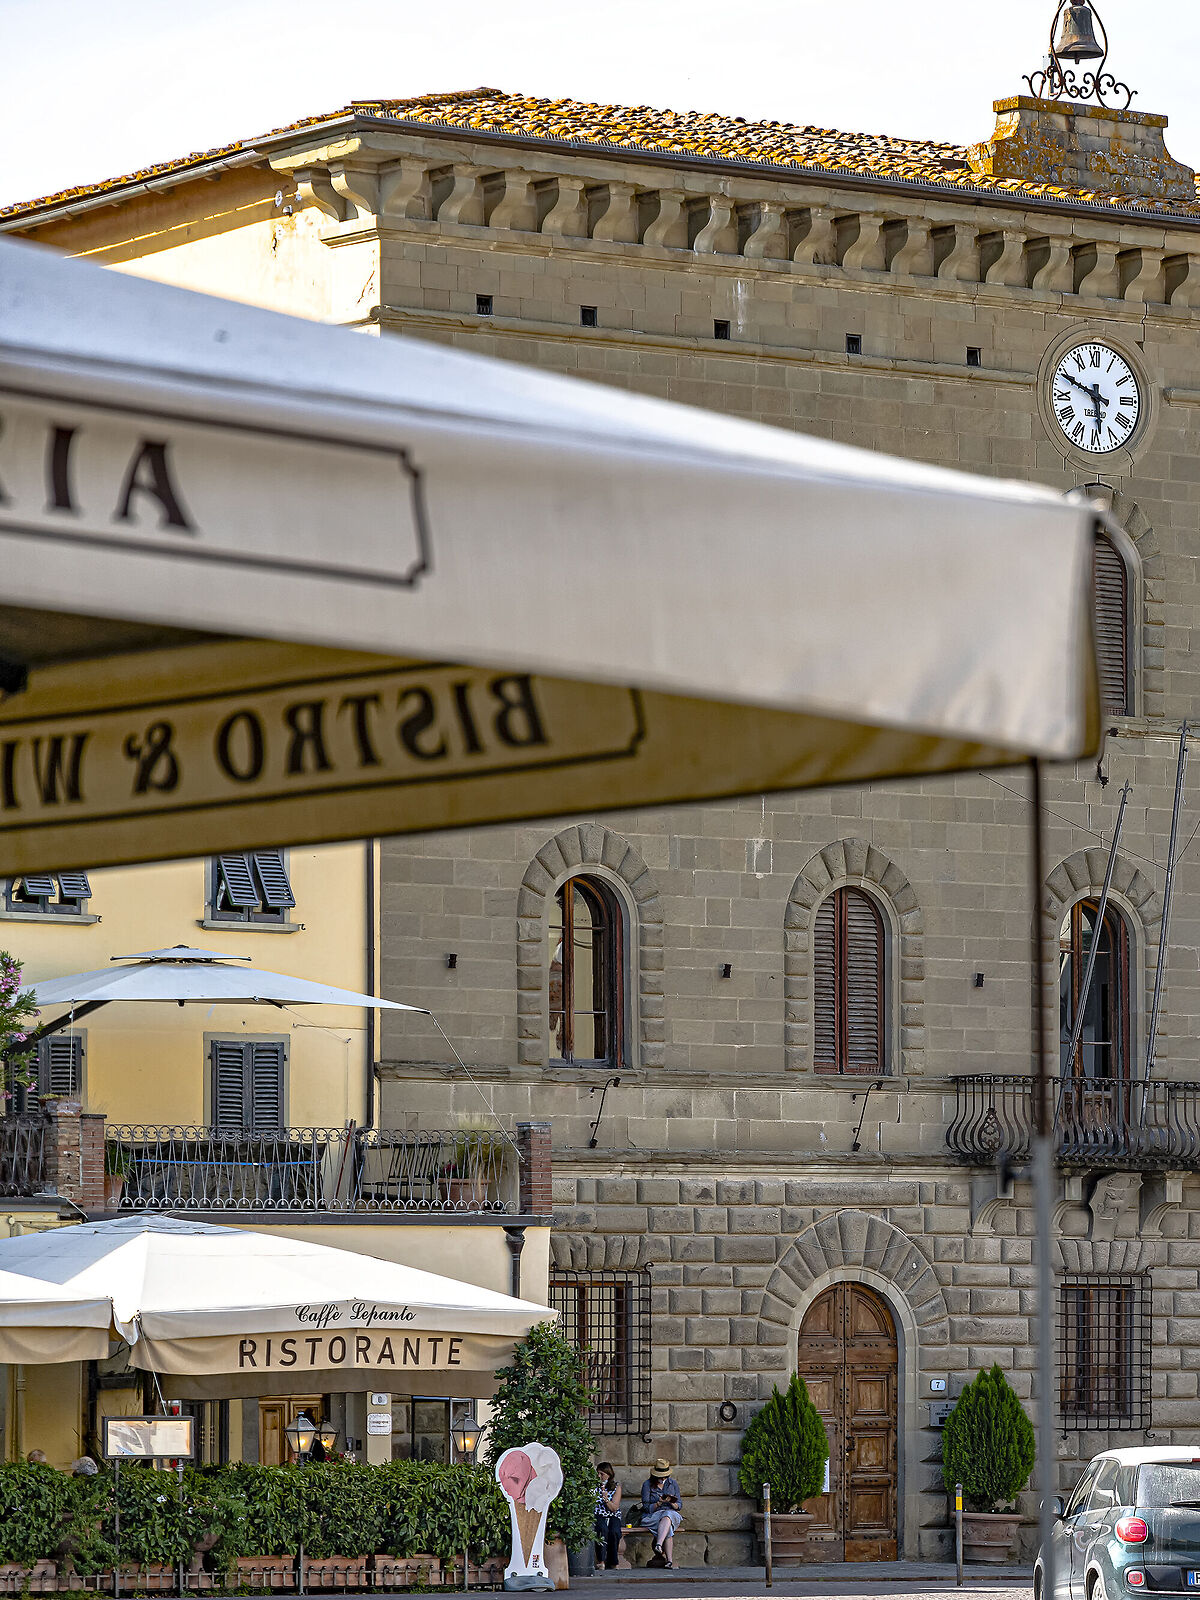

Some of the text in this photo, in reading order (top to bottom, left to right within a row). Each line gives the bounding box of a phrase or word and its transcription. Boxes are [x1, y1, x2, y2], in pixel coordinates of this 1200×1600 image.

[1089, 350, 1101, 368] XII
[0, 414, 198, 534] IA
[295, 1302, 416, 1328] Caffè Lepanto
[239, 1336, 463, 1368] RISTORANTE
